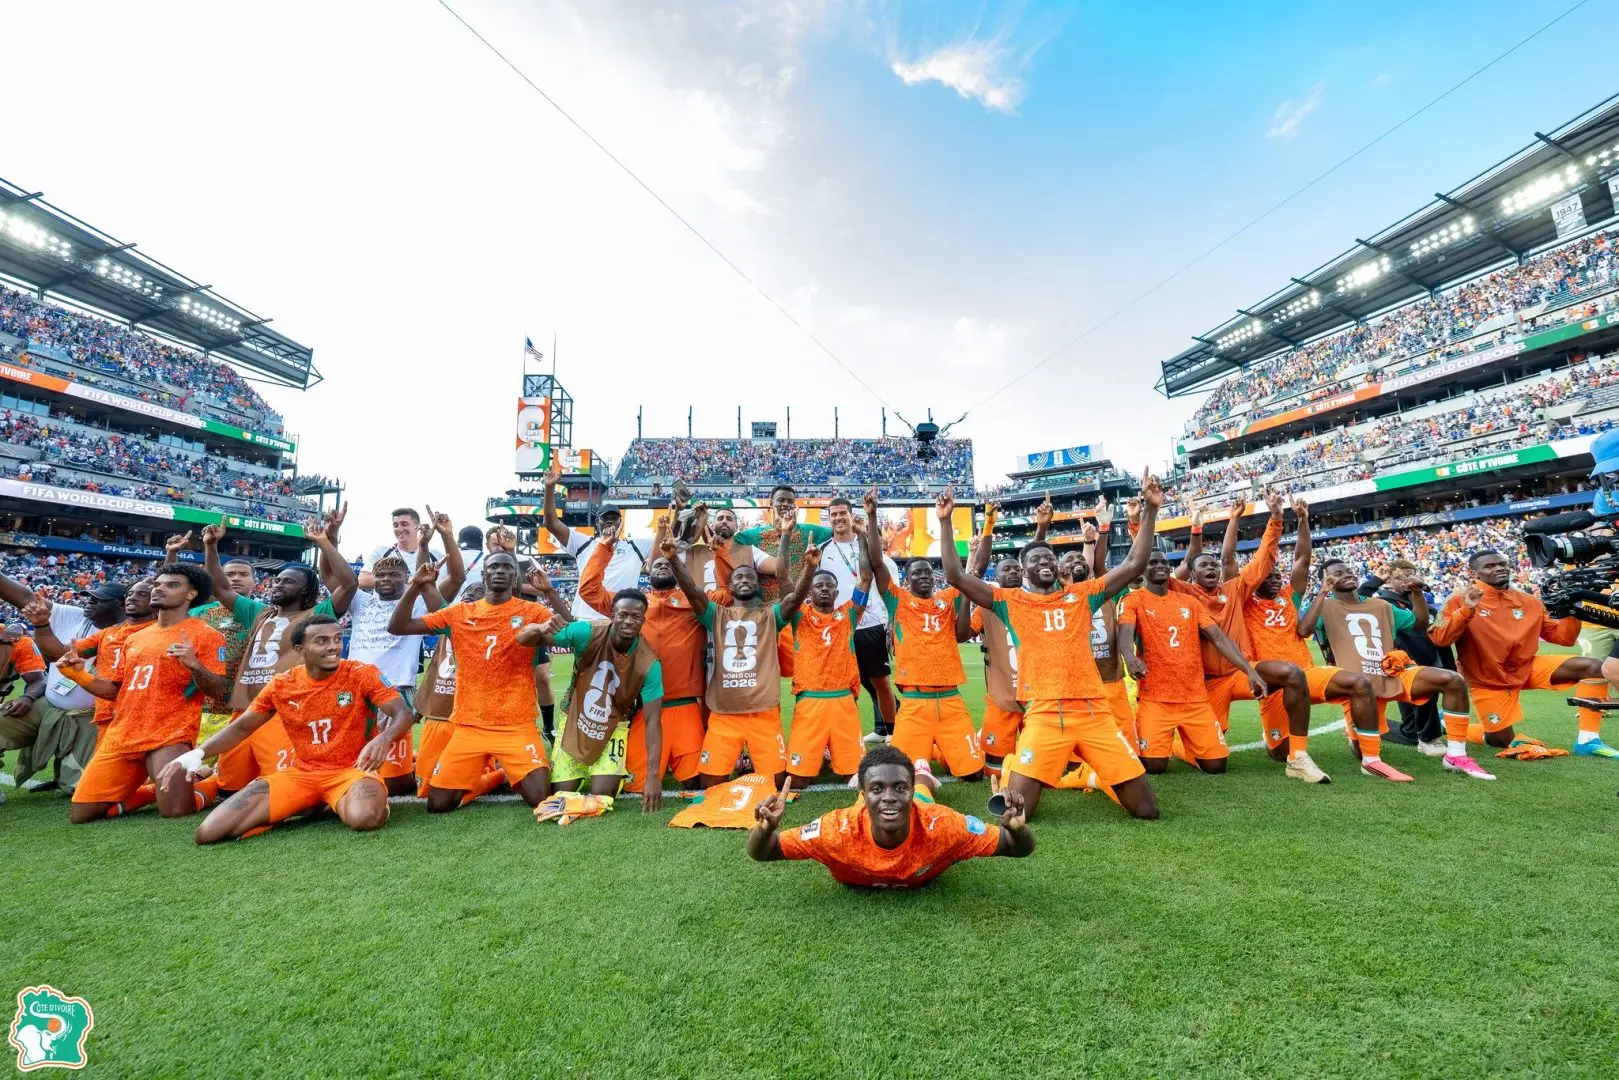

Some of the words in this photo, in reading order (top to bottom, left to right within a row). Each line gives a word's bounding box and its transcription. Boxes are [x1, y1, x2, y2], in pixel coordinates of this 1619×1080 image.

[1415, 363, 1456, 380] WORLD
[1456, 357, 1479, 370] CUP
[84, 389, 109, 401] FIFA
[109, 395, 150, 412] WORLD
[152, 407, 172, 418] CUP
[1456, 460, 1479, 473] CÔTE
[23, 485, 54, 498] FIFA
[57, 490, 106, 506] WORLD
[107, 498, 134, 510] CUP
[103, 545, 195, 560] PHILADELHIA
[922, 613, 941, 632] 14
[1042, 608, 1067, 632] 18
[1264, 608, 1287, 627] 24
[821, 625, 832, 647] 4
[1168, 625, 1180, 648] 2
[485, 635, 497, 660] 7
[127, 664, 154, 691] 13
[240, 675, 274, 685] 2026
[1362, 666, 1388, 677] 202
[434, 685, 456, 695] 202
[722, 679, 757, 688] 2026
[589, 706, 606, 718] FIFA
[308, 718, 332, 745] 17
[577, 718, 606, 740] 2026
[1214, 720, 1224, 742] 2
[386, 739, 407, 761] 20
[609, 738, 625, 758] 16
[776, 734, 786, 754] 3
[719, 784, 753, 812] 3
